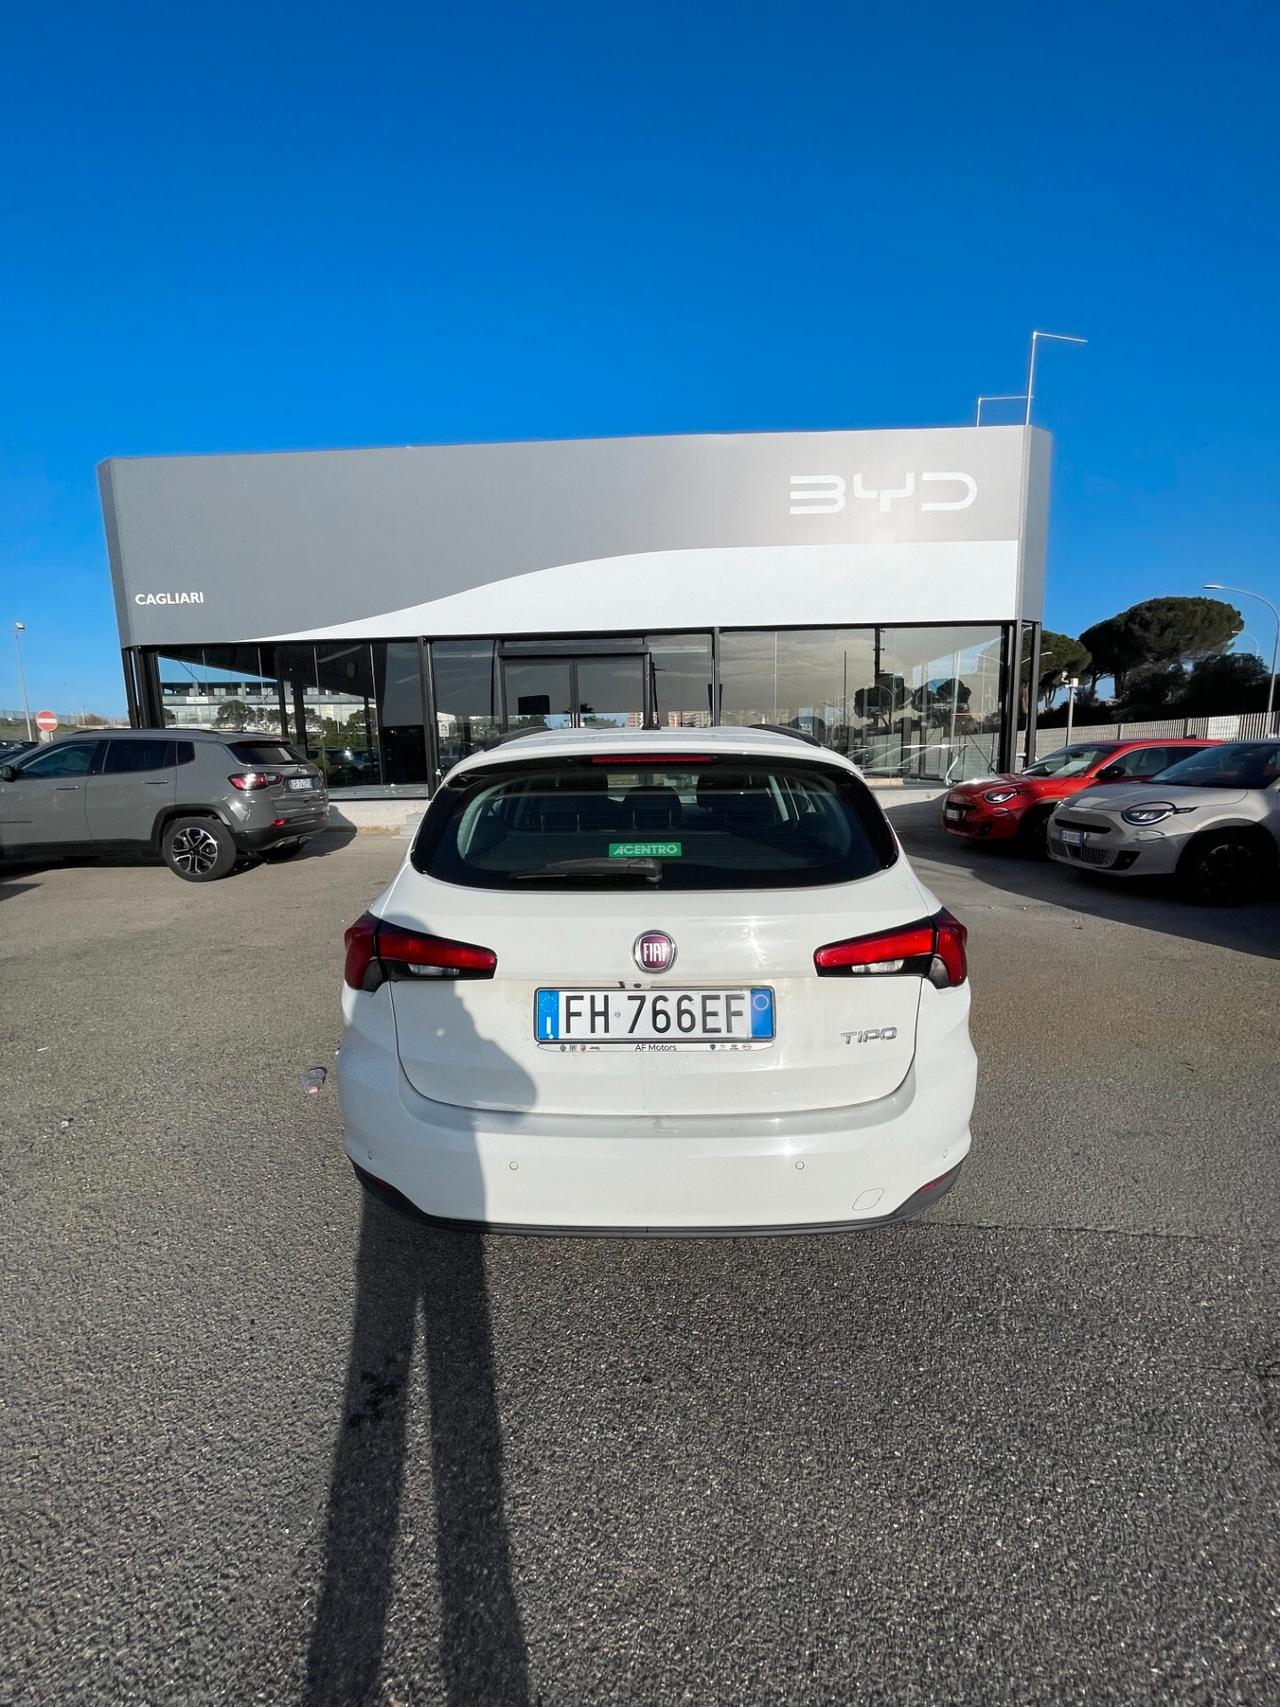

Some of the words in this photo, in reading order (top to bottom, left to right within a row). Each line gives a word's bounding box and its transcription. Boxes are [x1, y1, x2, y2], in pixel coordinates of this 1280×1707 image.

[790, 472, 978, 514] BYD
[134, 592, 205, 606] CAGLIARI
[614, 844, 678, 855] ACENTRO
[643, 942, 668, 962] FIAT
[565, 994, 610, 1034] FH
[626, 994, 746, 1034] 766EF
[840, 1026, 897, 1045] TIPO
[635, 1044, 647, 1052] AF
[648, 1043, 678, 1052] Motors
